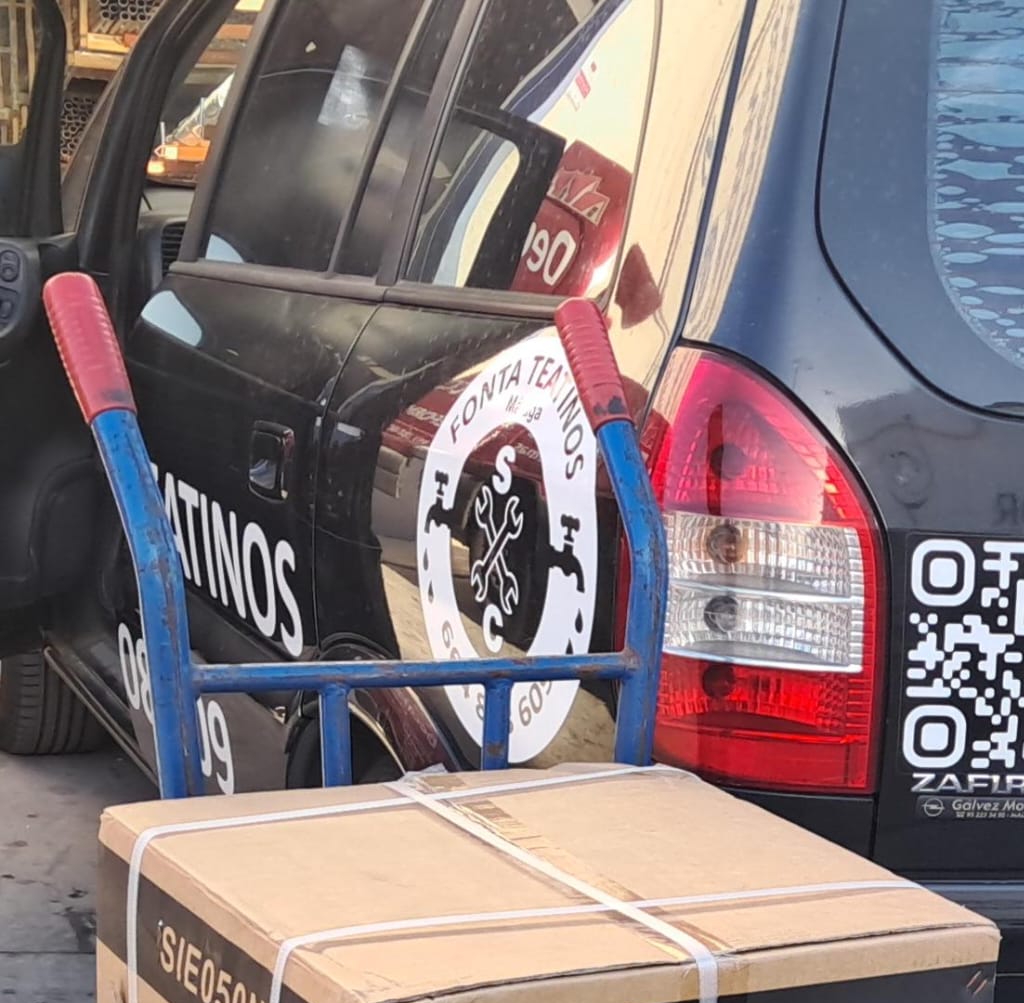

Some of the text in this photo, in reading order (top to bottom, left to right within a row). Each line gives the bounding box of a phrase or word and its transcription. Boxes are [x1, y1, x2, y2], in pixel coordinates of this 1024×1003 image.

[449, 360, 522, 445] FONTA
[492, 445, 516, 495] S
[150, 461, 304, 658] ATINOS
